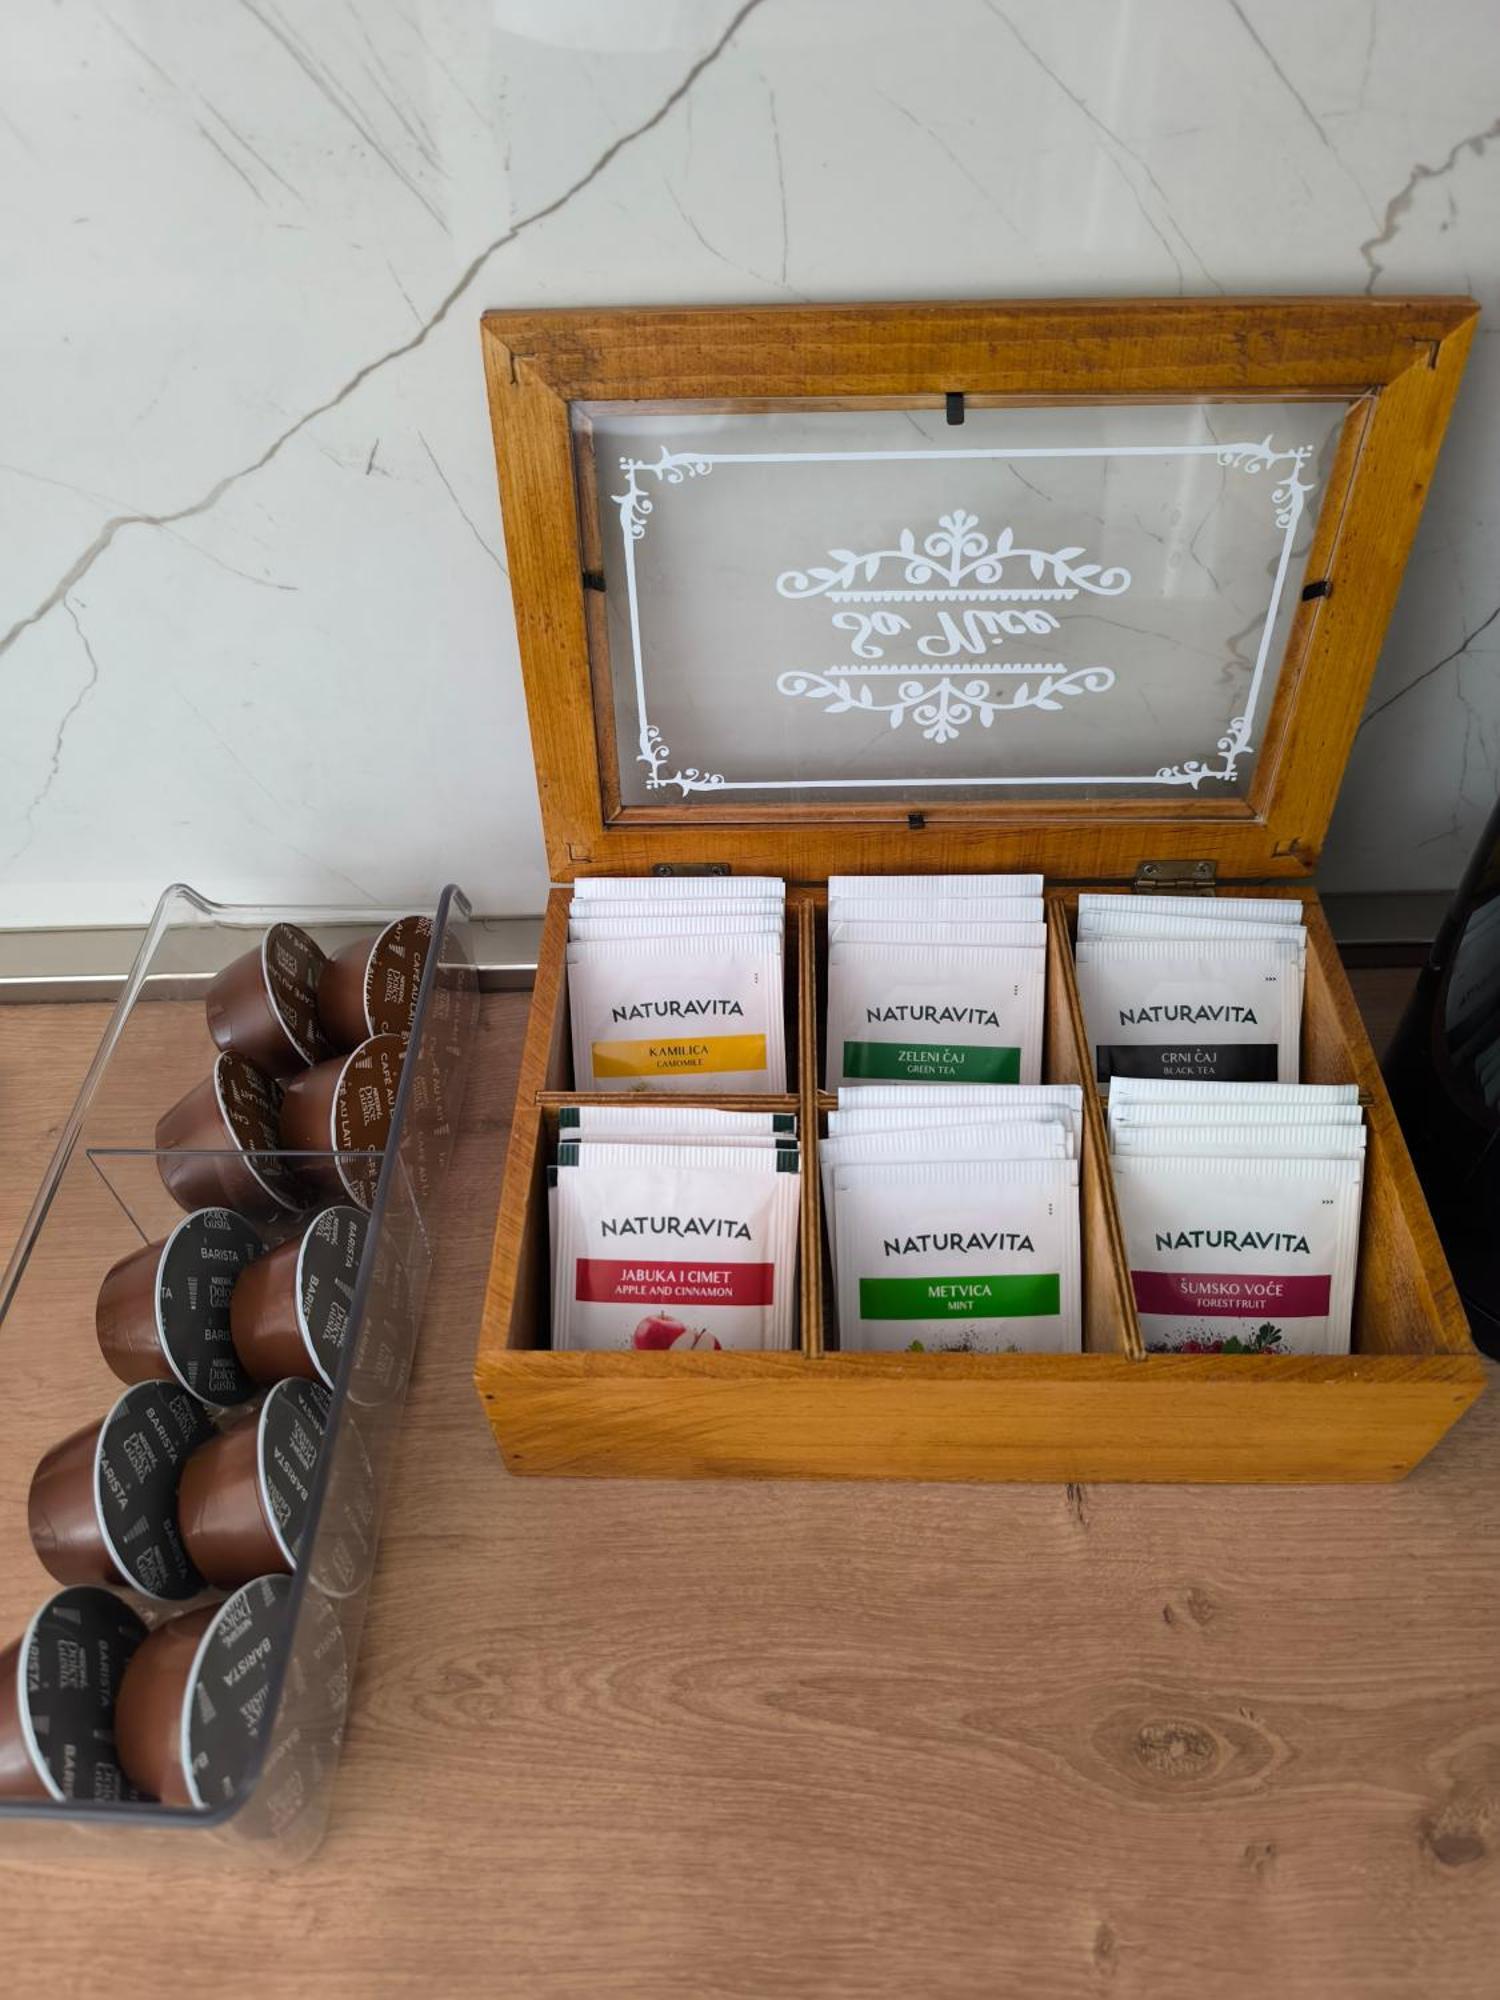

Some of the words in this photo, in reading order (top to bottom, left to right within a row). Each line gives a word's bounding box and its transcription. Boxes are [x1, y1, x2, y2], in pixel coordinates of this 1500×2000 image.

[612, 999, 744, 1023] NATURAVITA
[866, 1005, 1000, 1027] NATURAVITA
[1119, 1005, 1258, 1026] NATURAVITA
[649, 1045, 709, 1058] KAMILICA
[898, 1051, 939, 1063] ZELENI
[942, 1048, 965, 1064] ČAJ
[1161, 1052, 1192, 1064] CRNI
[1194, 1047, 1217, 1064] ČAJ
[907, 1064, 935, 1074] GREEN
[938, 1066, 955, 1075] TEA
[1163, 1066, 1194, 1075] BLACK
[1198, 1066, 1216, 1075] TEA
[339, 1100, 349, 1118] AU
[341, 1121, 352, 1148] LAIT
[601, 1216, 752, 1241] NATURAVITA
[345, 1220, 358, 1268] BARISTA
[884, 1232, 1035, 1257] NATURAVITA
[1155, 1230, 1311, 1254] NATURAVITA
[200, 1247, 240, 1262] BARISTA
[620, 1269, 676, 1283] JABUKA
[687, 1270, 733, 1284] CIMET
[615, 1285, 646, 1296] APPLE
[650, 1286, 673, 1296] AND
[674, 1286, 733, 1297] CINNAMON
[928, 1285, 992, 1299] METVICA
[1180, 1277, 1240, 1296] ŠUMSKO
[948, 1300, 975, 1311] MINT
[1197, 1299, 1233, 1310] FOREST
[1235, 1300, 1267, 1310] FRUIT
[145, 1406, 179, 1465] BARISTA
[273, 1445, 310, 1502] BARISTA
[222, 1636, 273, 1688] BARISTA
[98, 1639, 112, 1708] BARISTA
